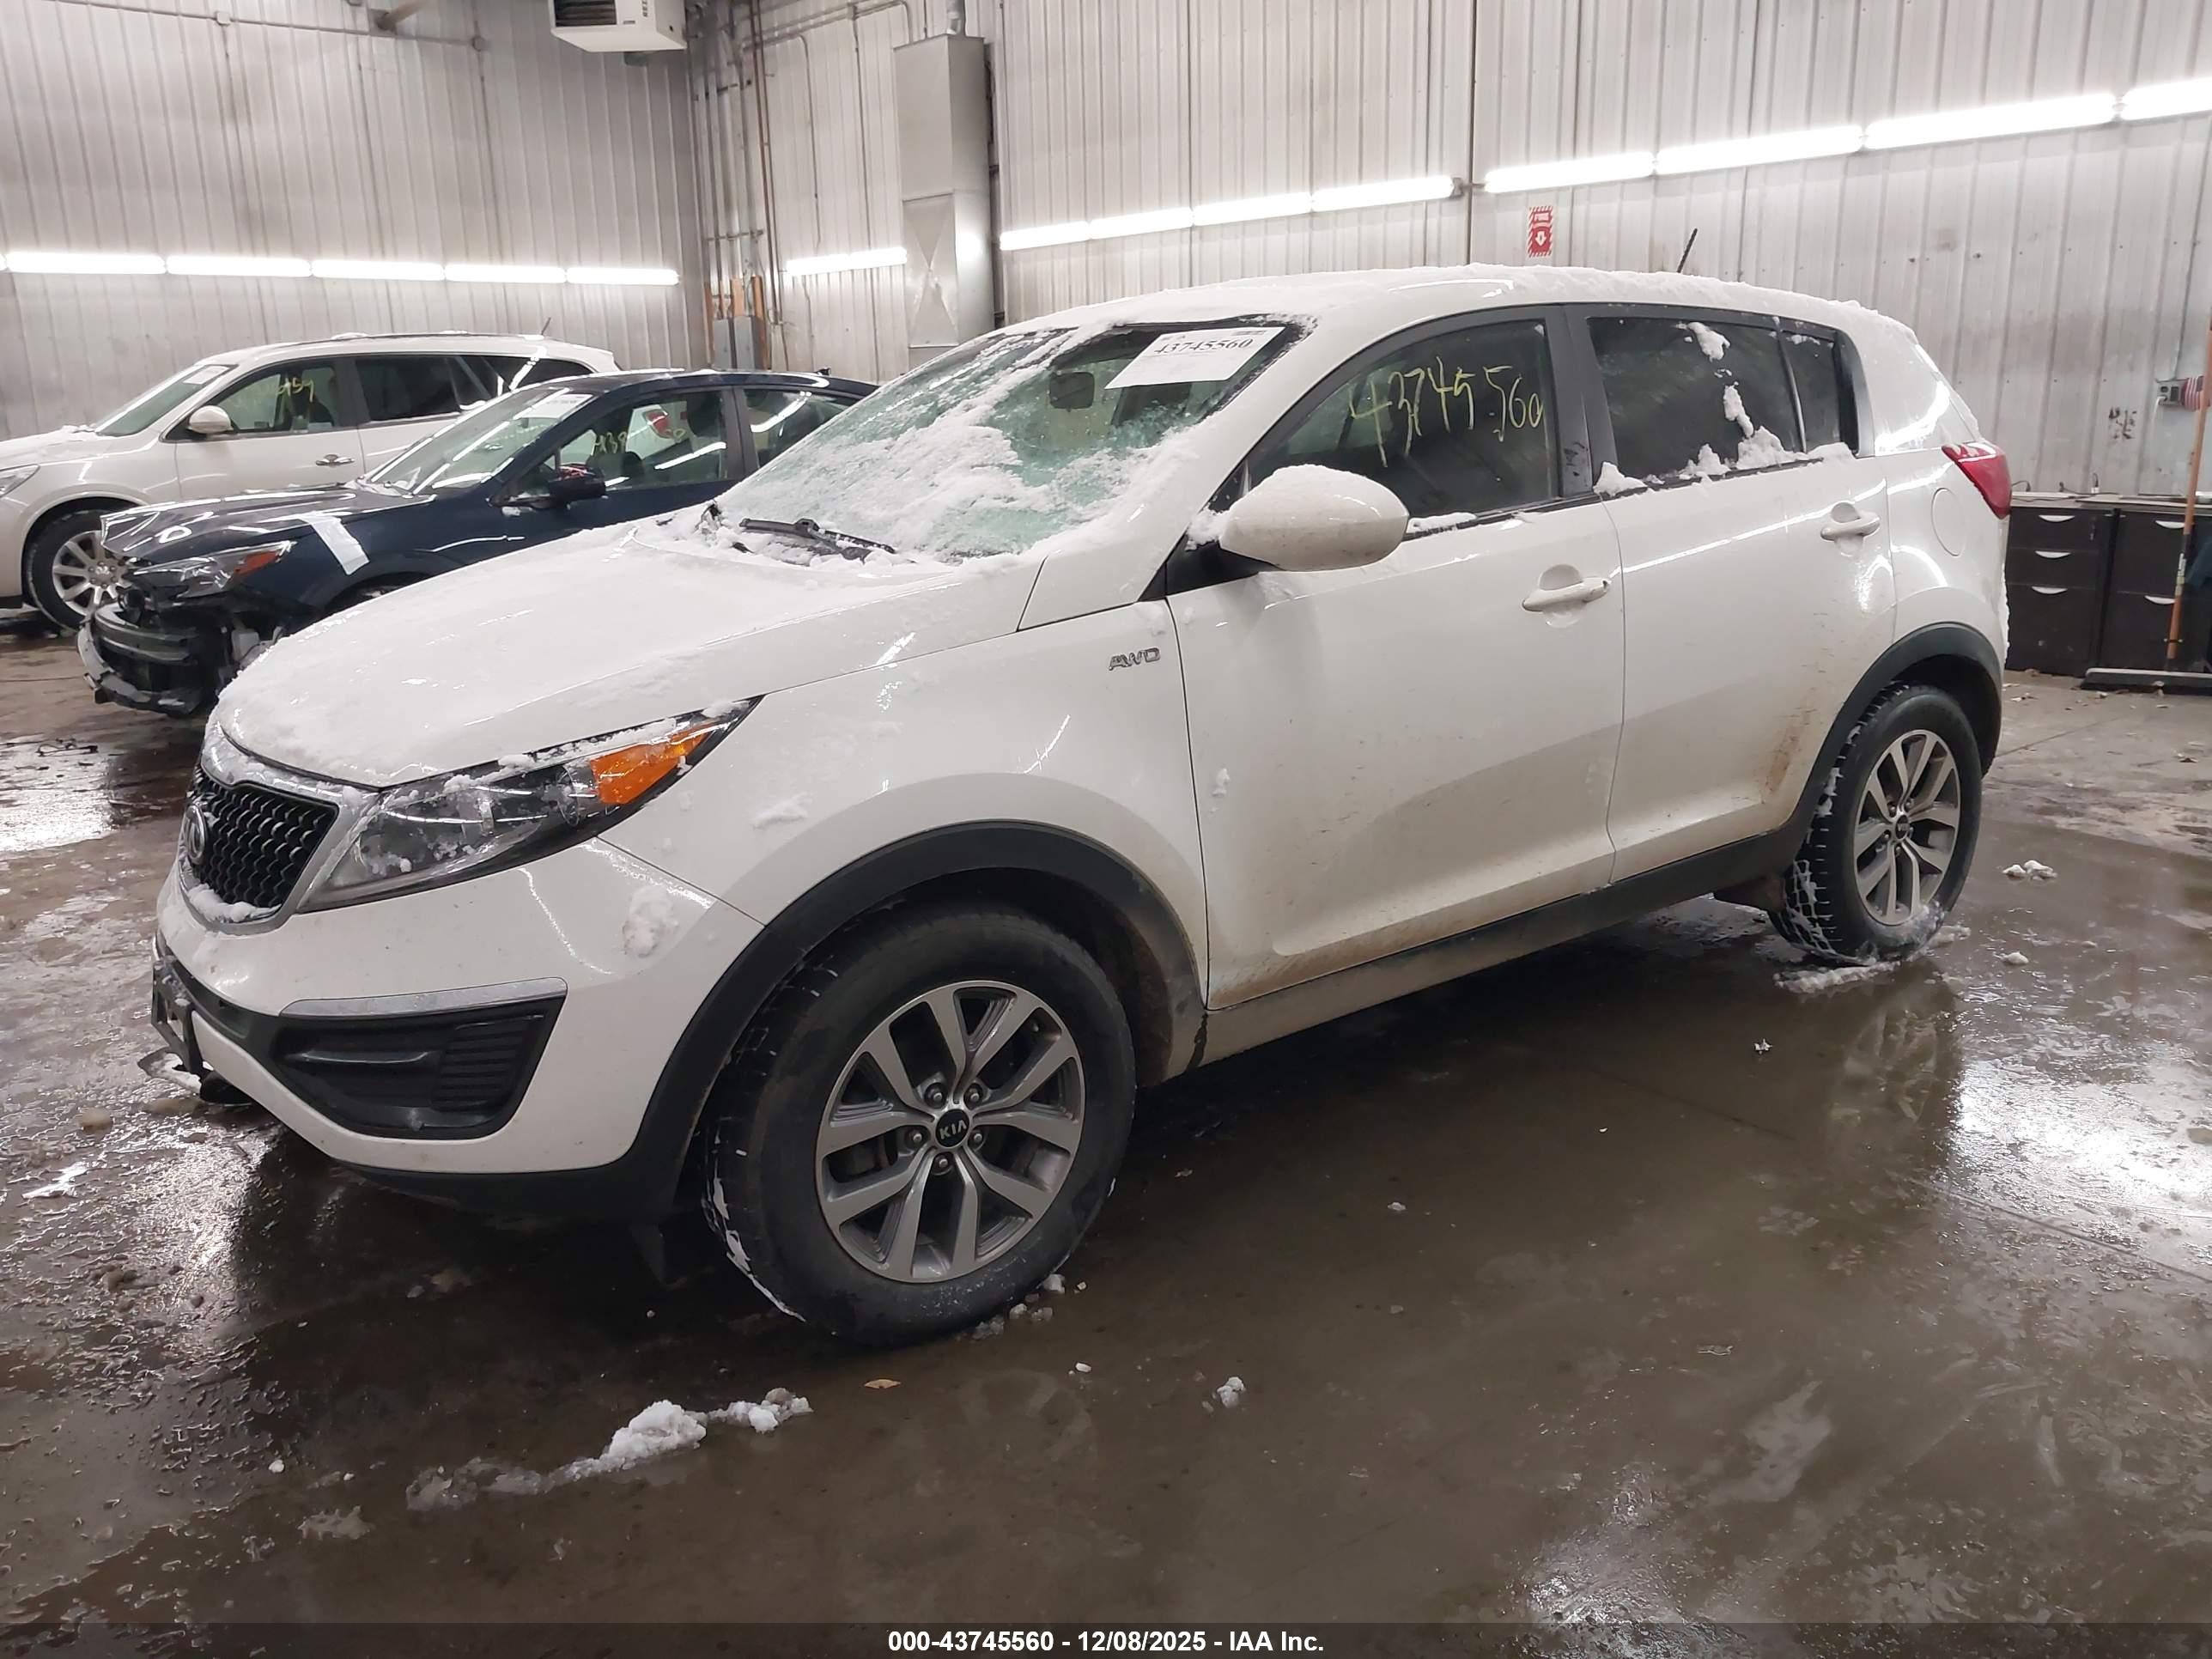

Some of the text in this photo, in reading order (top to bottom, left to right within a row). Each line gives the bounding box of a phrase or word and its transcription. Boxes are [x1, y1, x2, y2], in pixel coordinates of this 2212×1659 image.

[1153, 337, 1255, 354] 43745560
[1109, 647, 1161, 671] AWD
[939, 1120, 967, 1139] KIA
